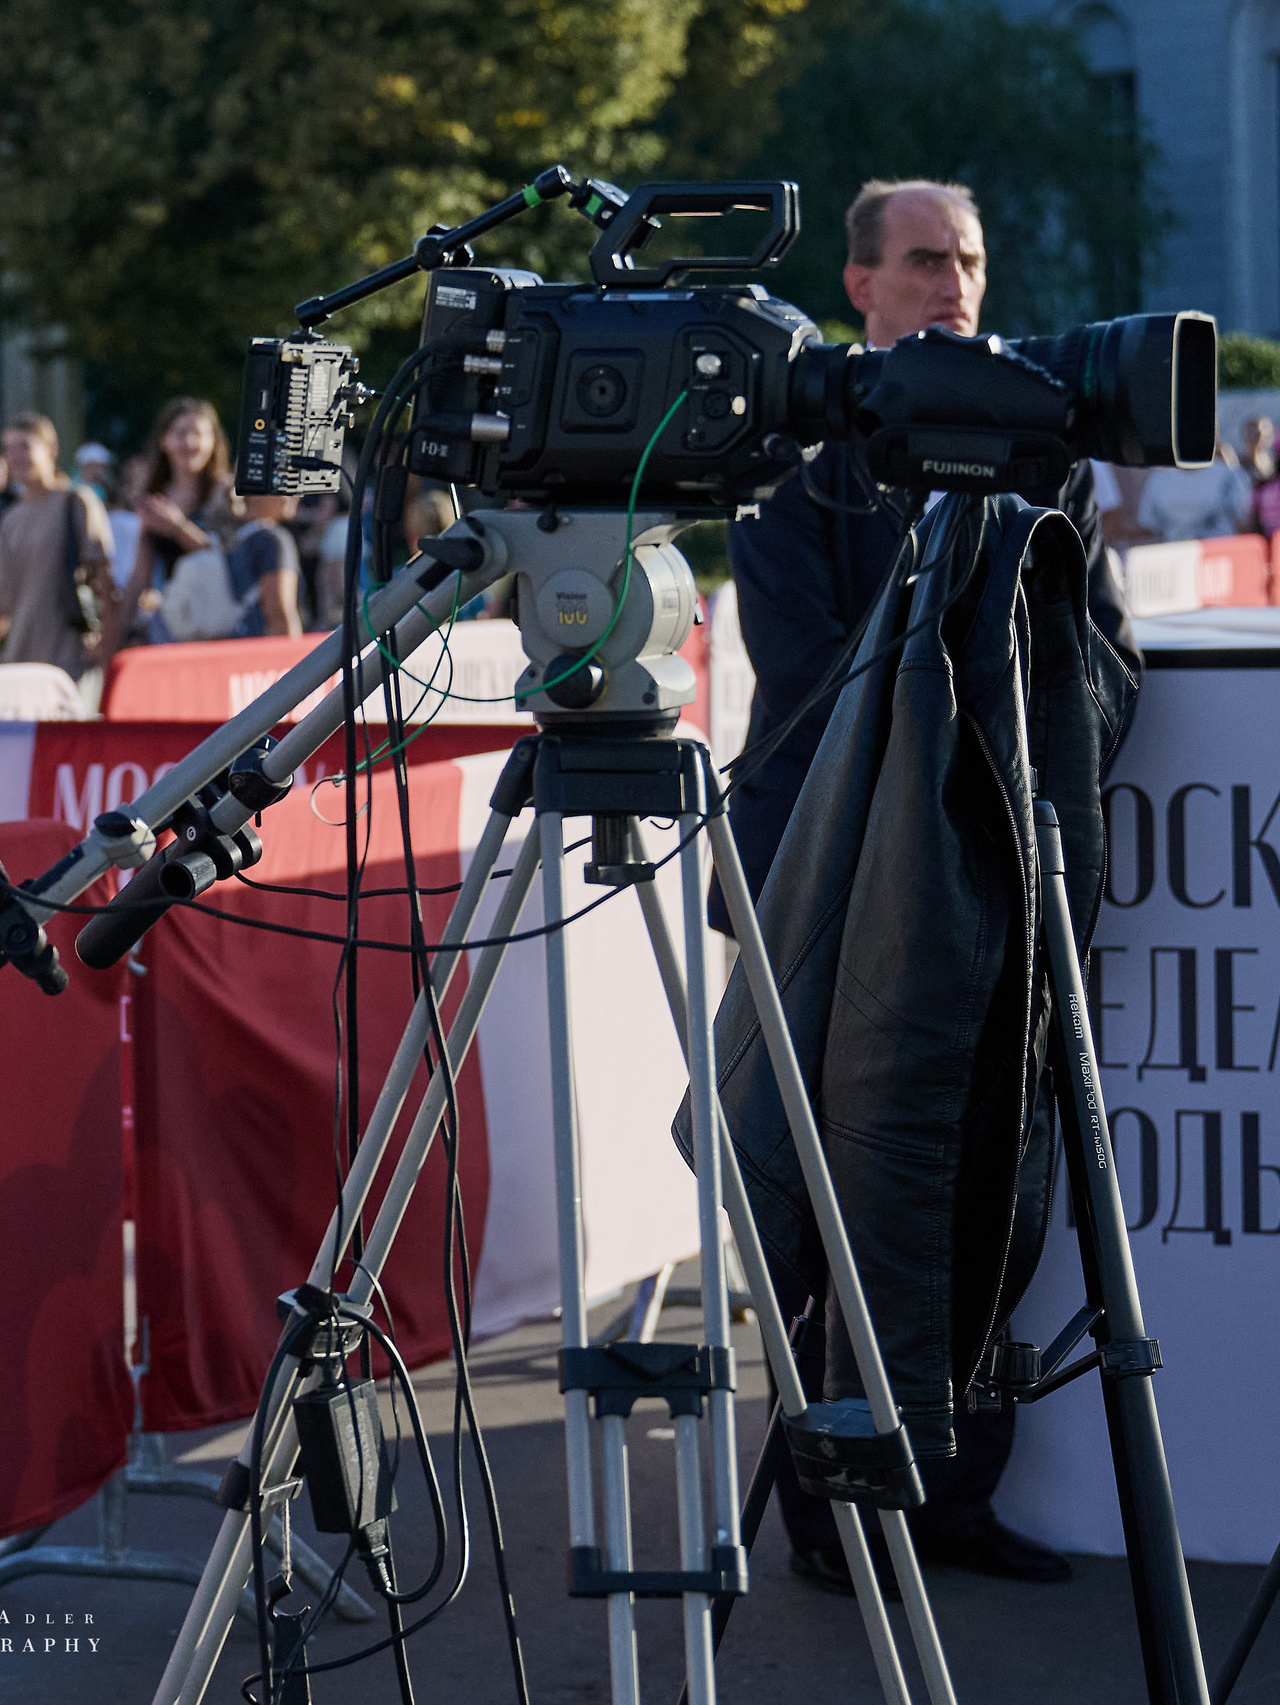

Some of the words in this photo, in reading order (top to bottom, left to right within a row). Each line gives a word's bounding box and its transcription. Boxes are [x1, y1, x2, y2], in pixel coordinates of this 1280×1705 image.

[922, 460, 995, 478] FUJINON
[558, 599, 588, 625] 100
[1099, 782, 1280, 908] ОСК
[1068, 993, 1084, 1039] Rekam
[1078, 1052, 1098, 1110] MaxiPod
